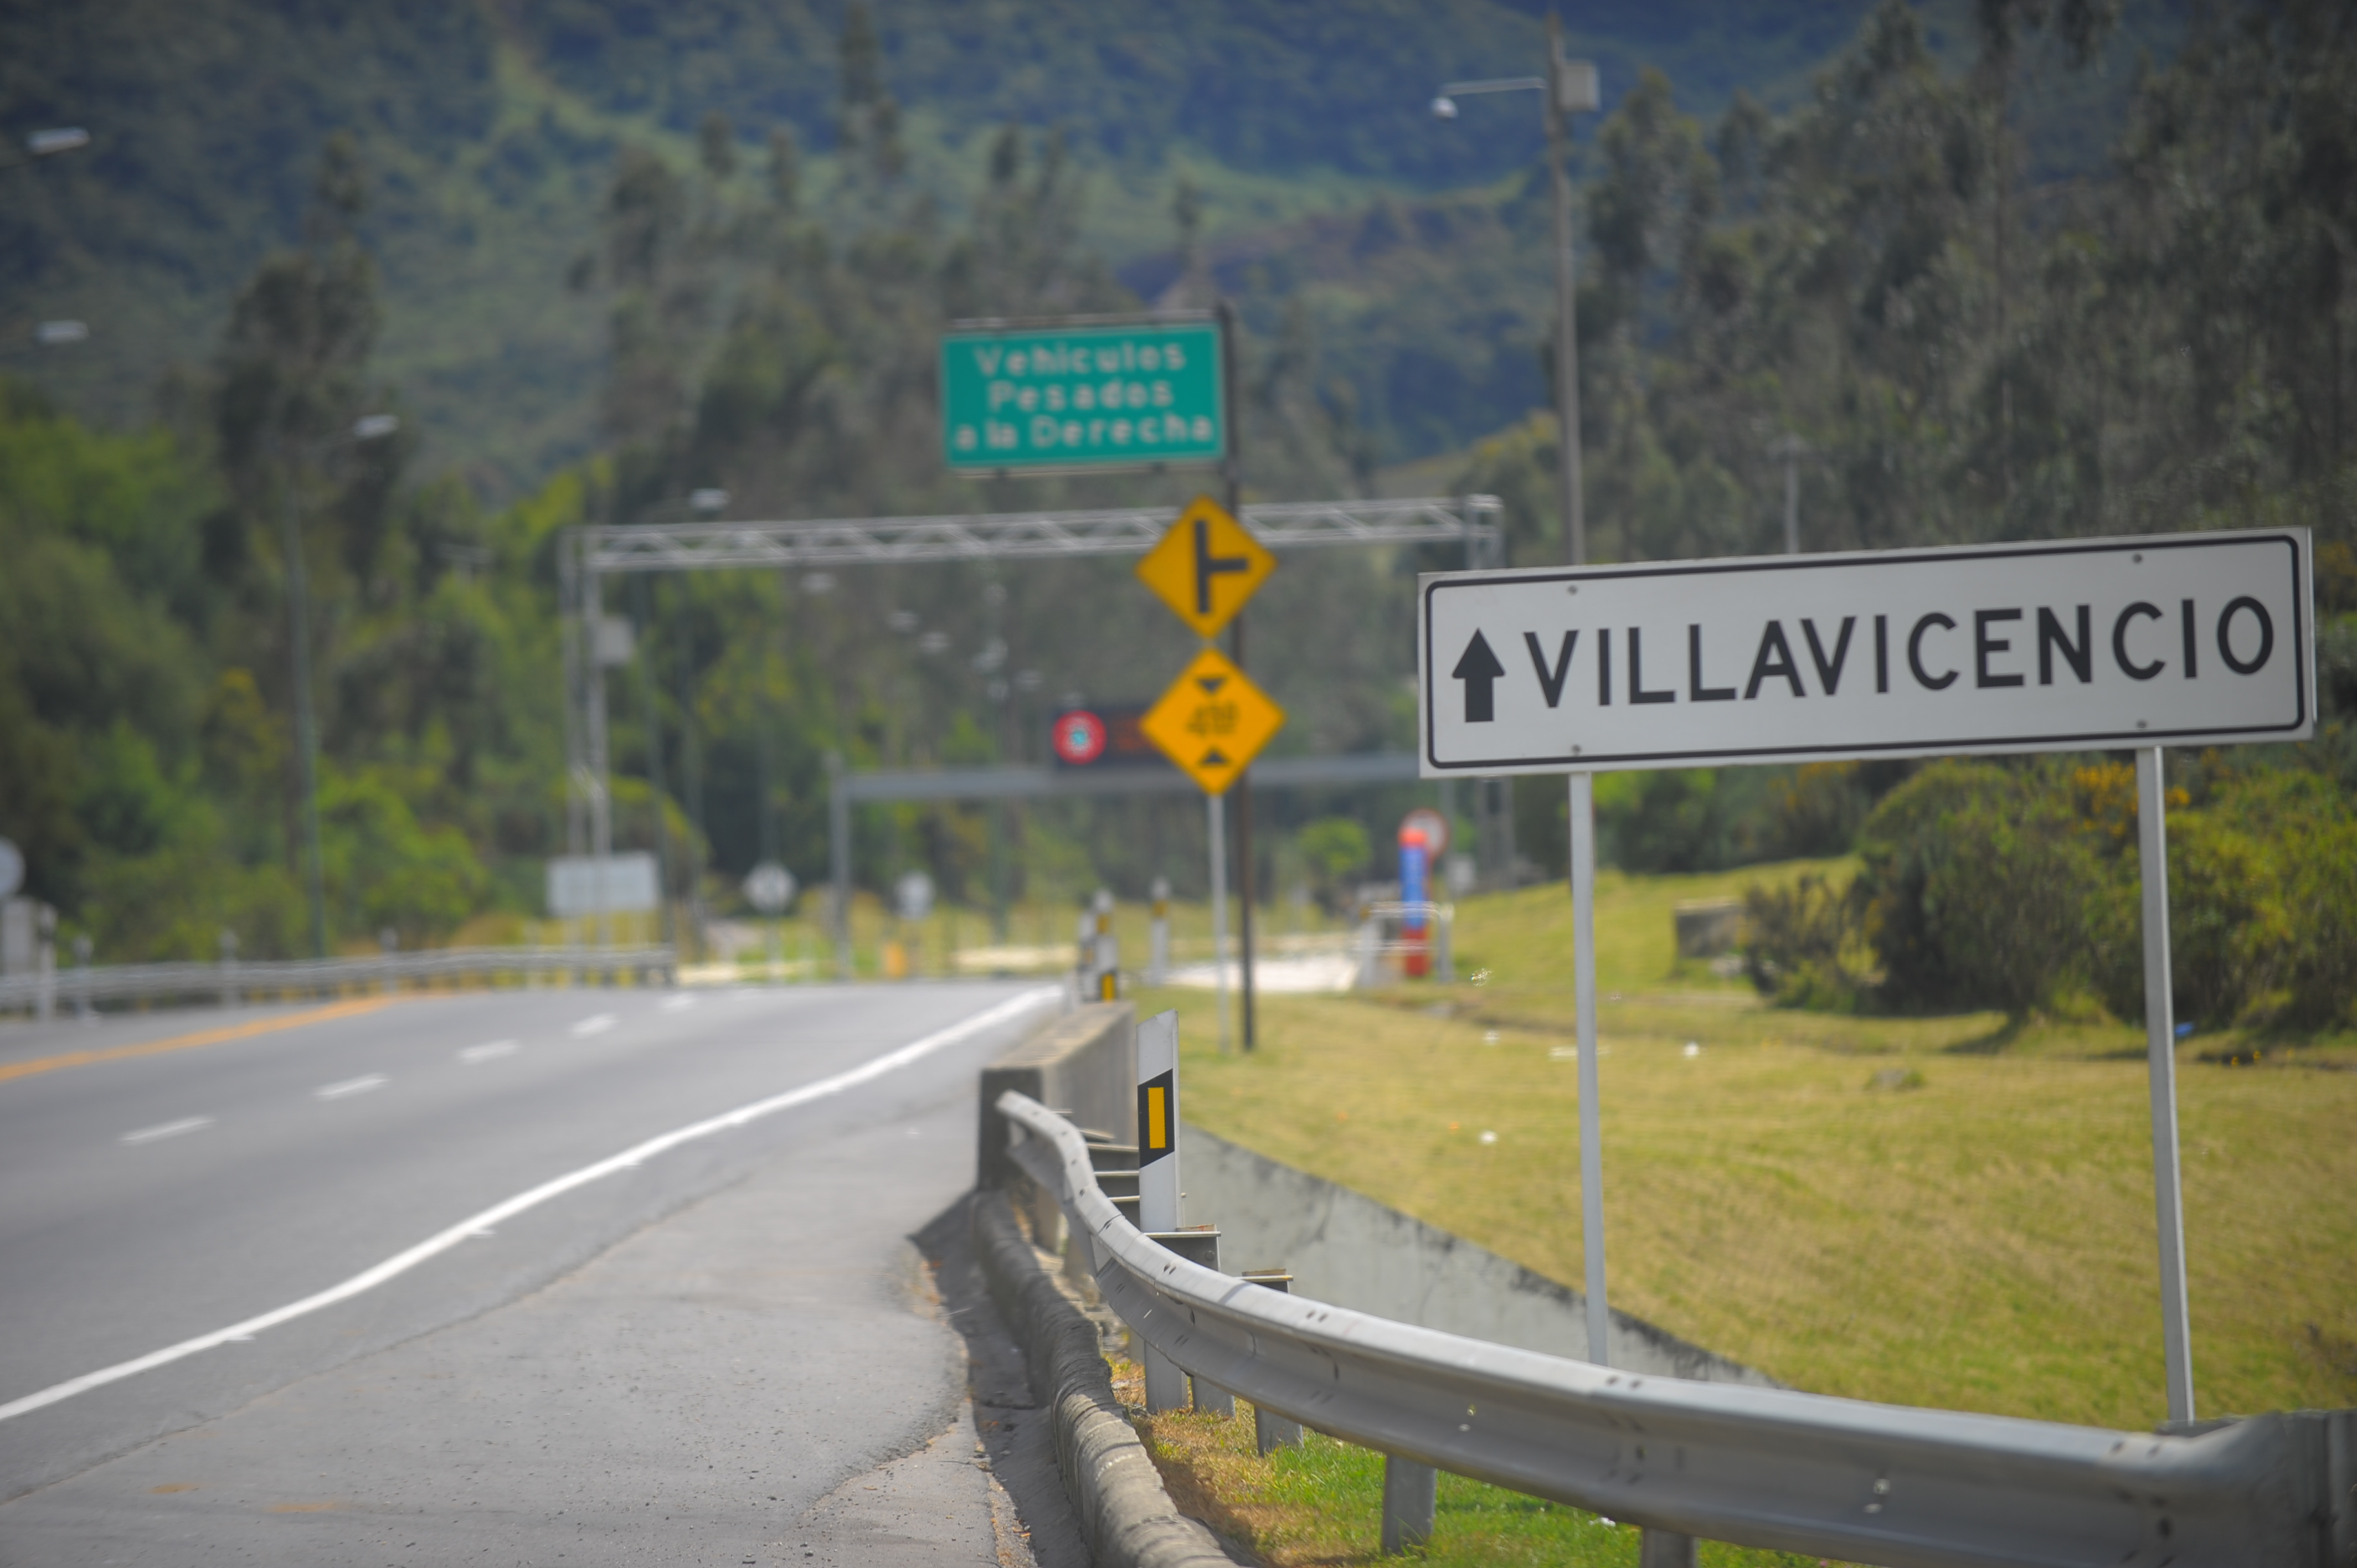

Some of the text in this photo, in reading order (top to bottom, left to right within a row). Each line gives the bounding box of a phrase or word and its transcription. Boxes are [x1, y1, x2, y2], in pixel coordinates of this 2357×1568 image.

[988, 379, 1174, 412] Pesados
[954, 414, 1213, 451] a la Derecha
[1523, 595, 2274, 708] VILLAVICENCIO
